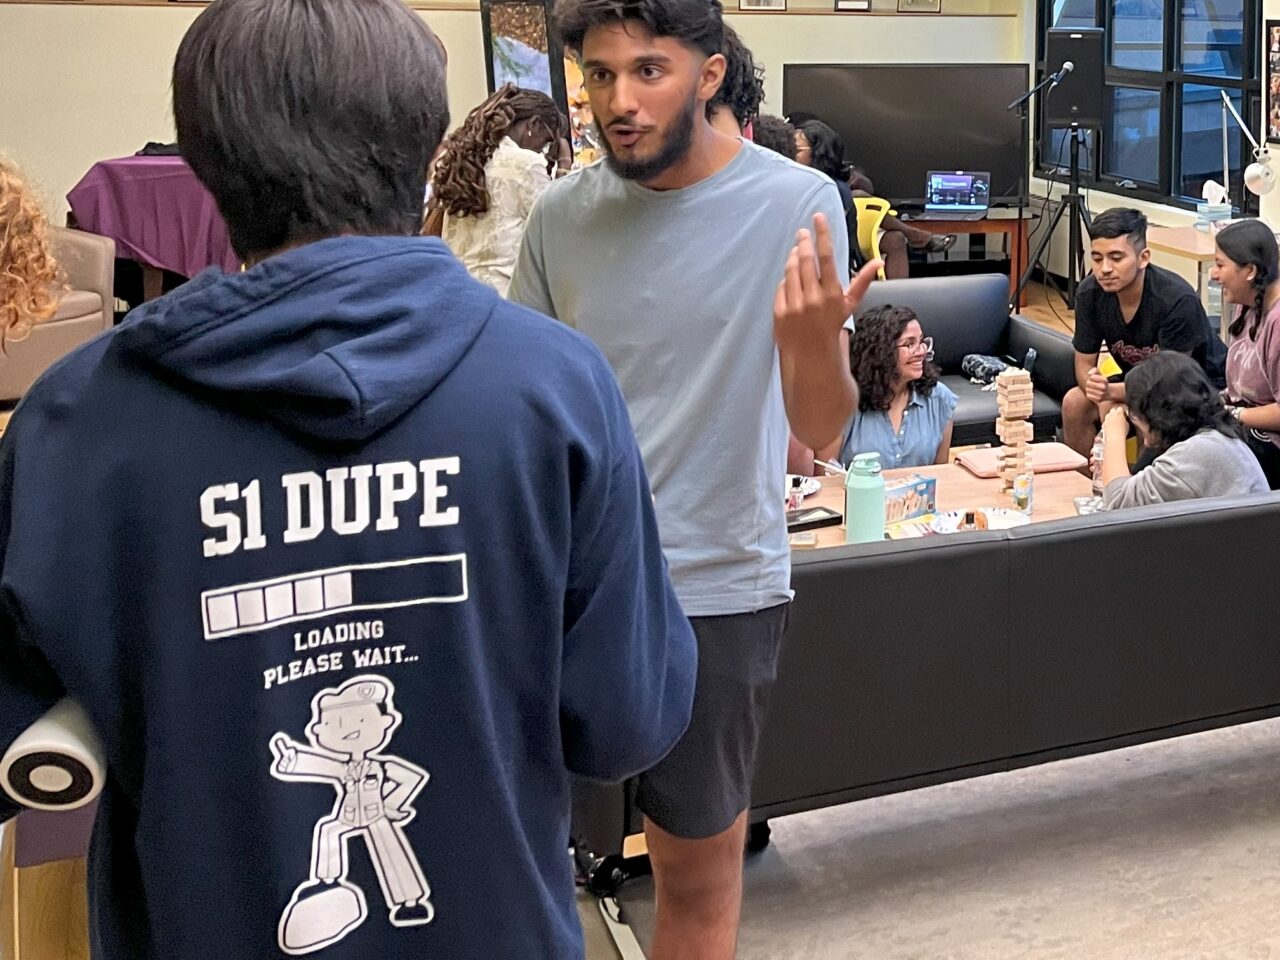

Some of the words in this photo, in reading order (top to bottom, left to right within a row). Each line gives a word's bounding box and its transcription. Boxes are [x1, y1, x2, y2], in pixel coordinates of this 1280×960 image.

[200, 479, 266, 557] S1
[281, 456, 460, 543] DUPE
[294, 620, 384, 651] LOADING
[263, 651, 343, 689] PLEASE
[352, 644, 419, 668] WAIT...
